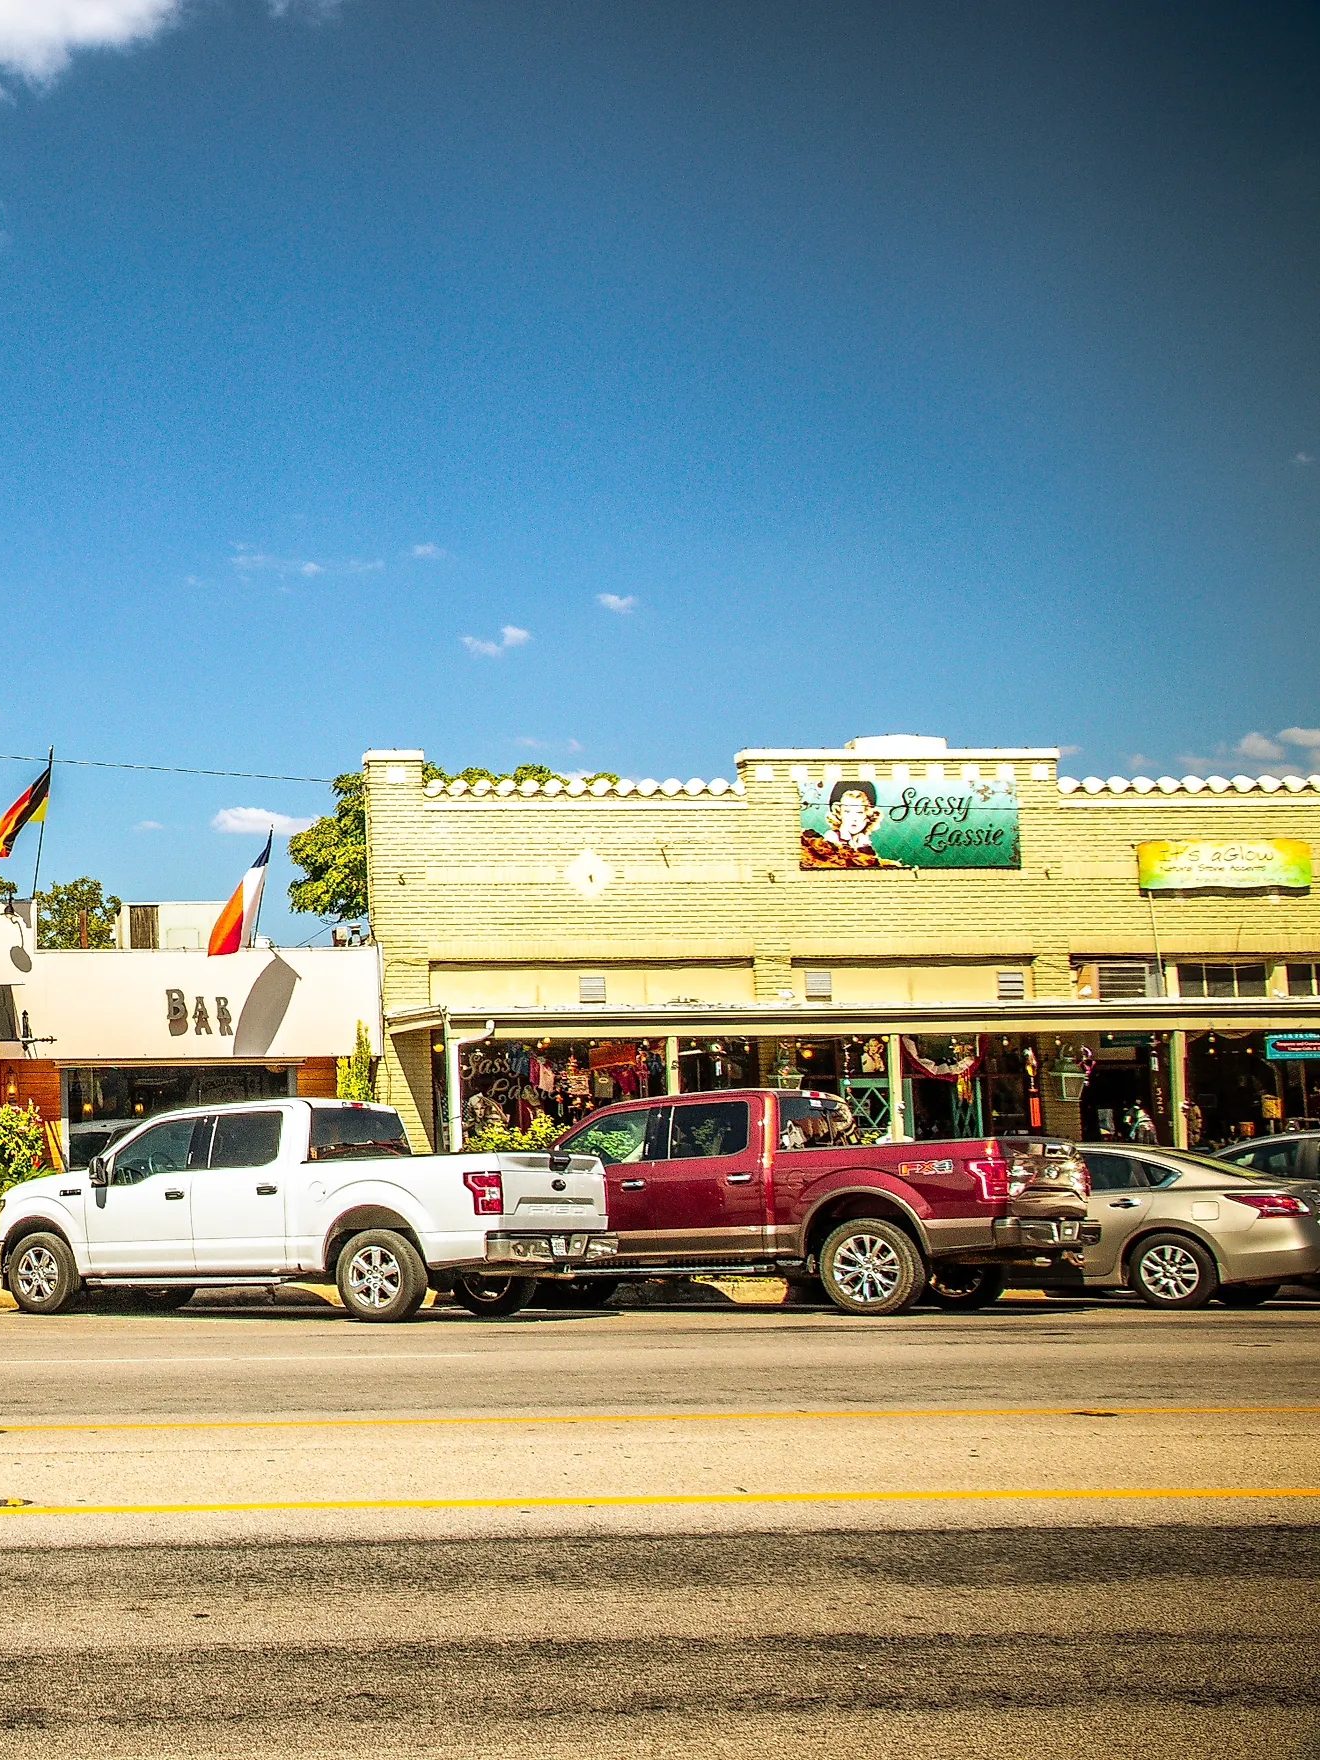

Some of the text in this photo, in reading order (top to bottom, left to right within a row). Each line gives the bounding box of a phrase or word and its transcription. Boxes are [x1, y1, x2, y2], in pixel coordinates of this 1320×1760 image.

[888, 787, 973, 823] Sassy
[924, 822, 1004, 853] Lassie
[1159, 845, 1200, 862] It's
[1197, 864, 1225, 872] Stone
[166, 989, 231, 1020] BAR
[460, 1053, 524, 1080] Sassy
[898, 1159, 953, 1176] FX4
[528, 1206, 586, 1216] F-150
